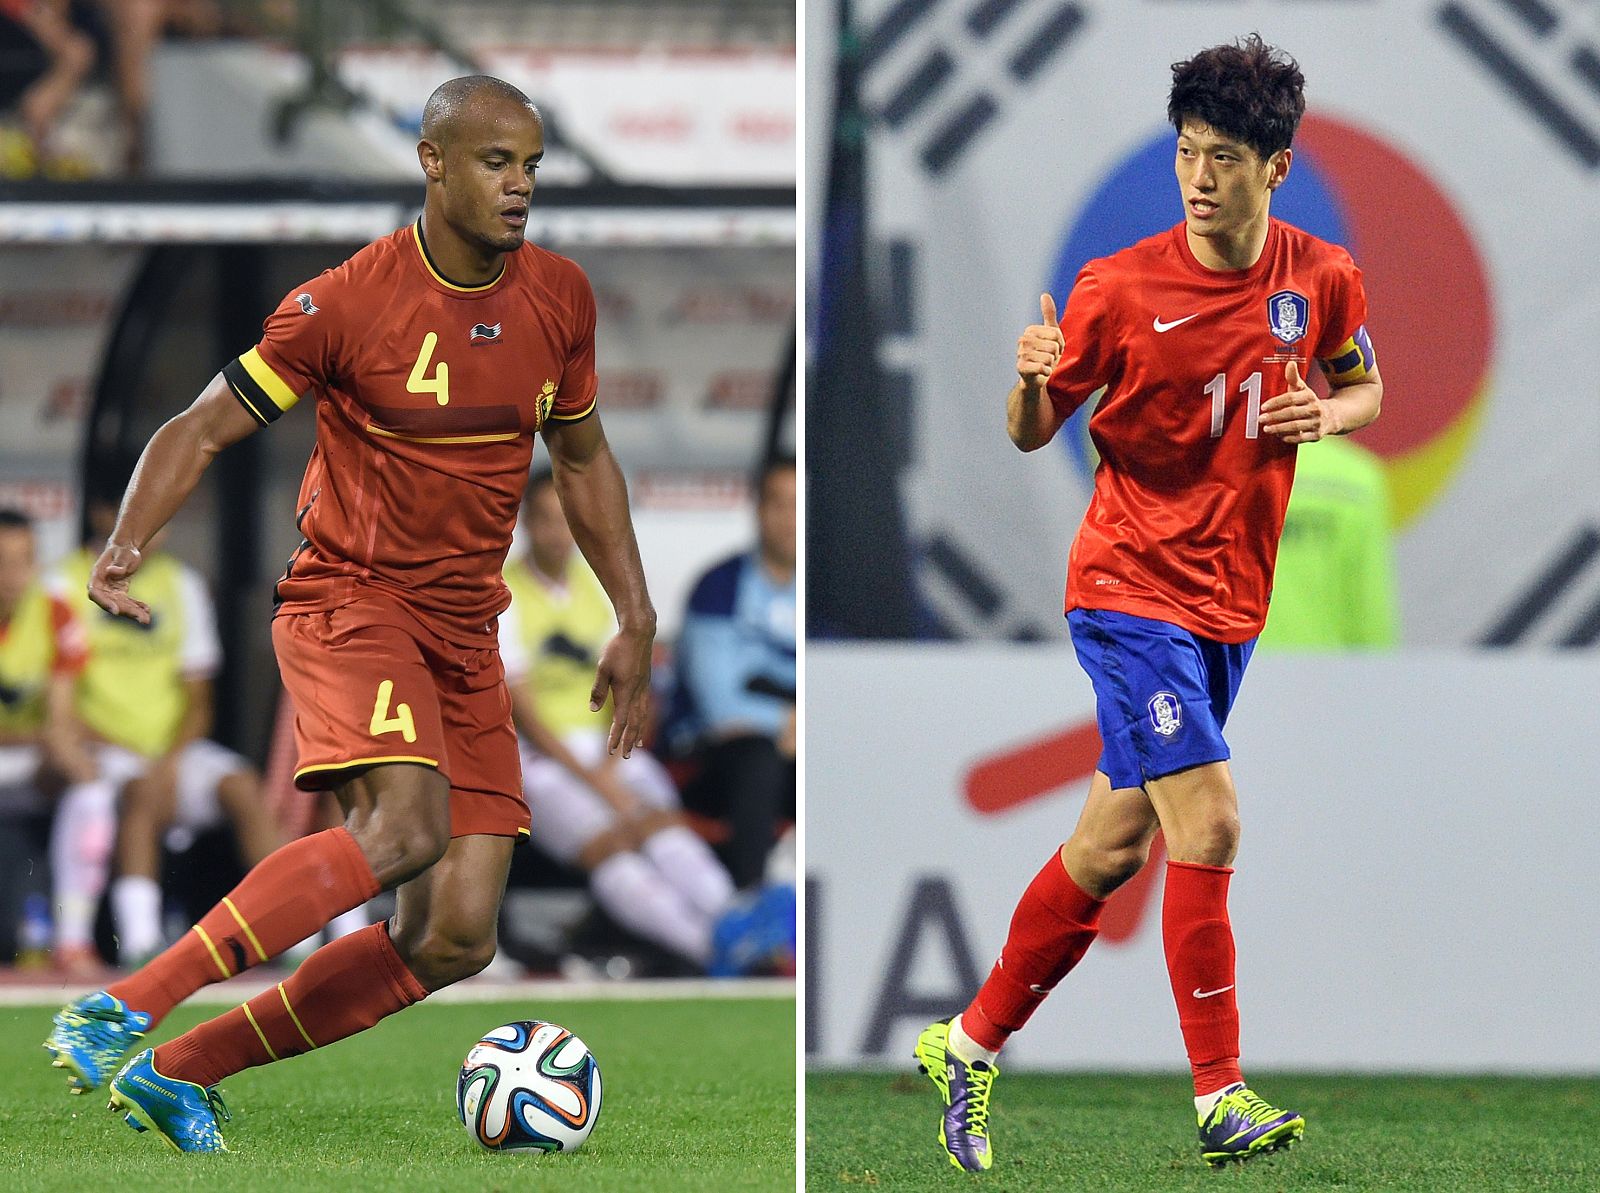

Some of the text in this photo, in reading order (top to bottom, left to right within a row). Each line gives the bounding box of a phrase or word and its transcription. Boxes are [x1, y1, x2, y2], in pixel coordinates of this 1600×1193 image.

[406, 331, 449, 406] 4
[1203, 371, 1262, 439] 11
[369, 679, 417, 743] 4
